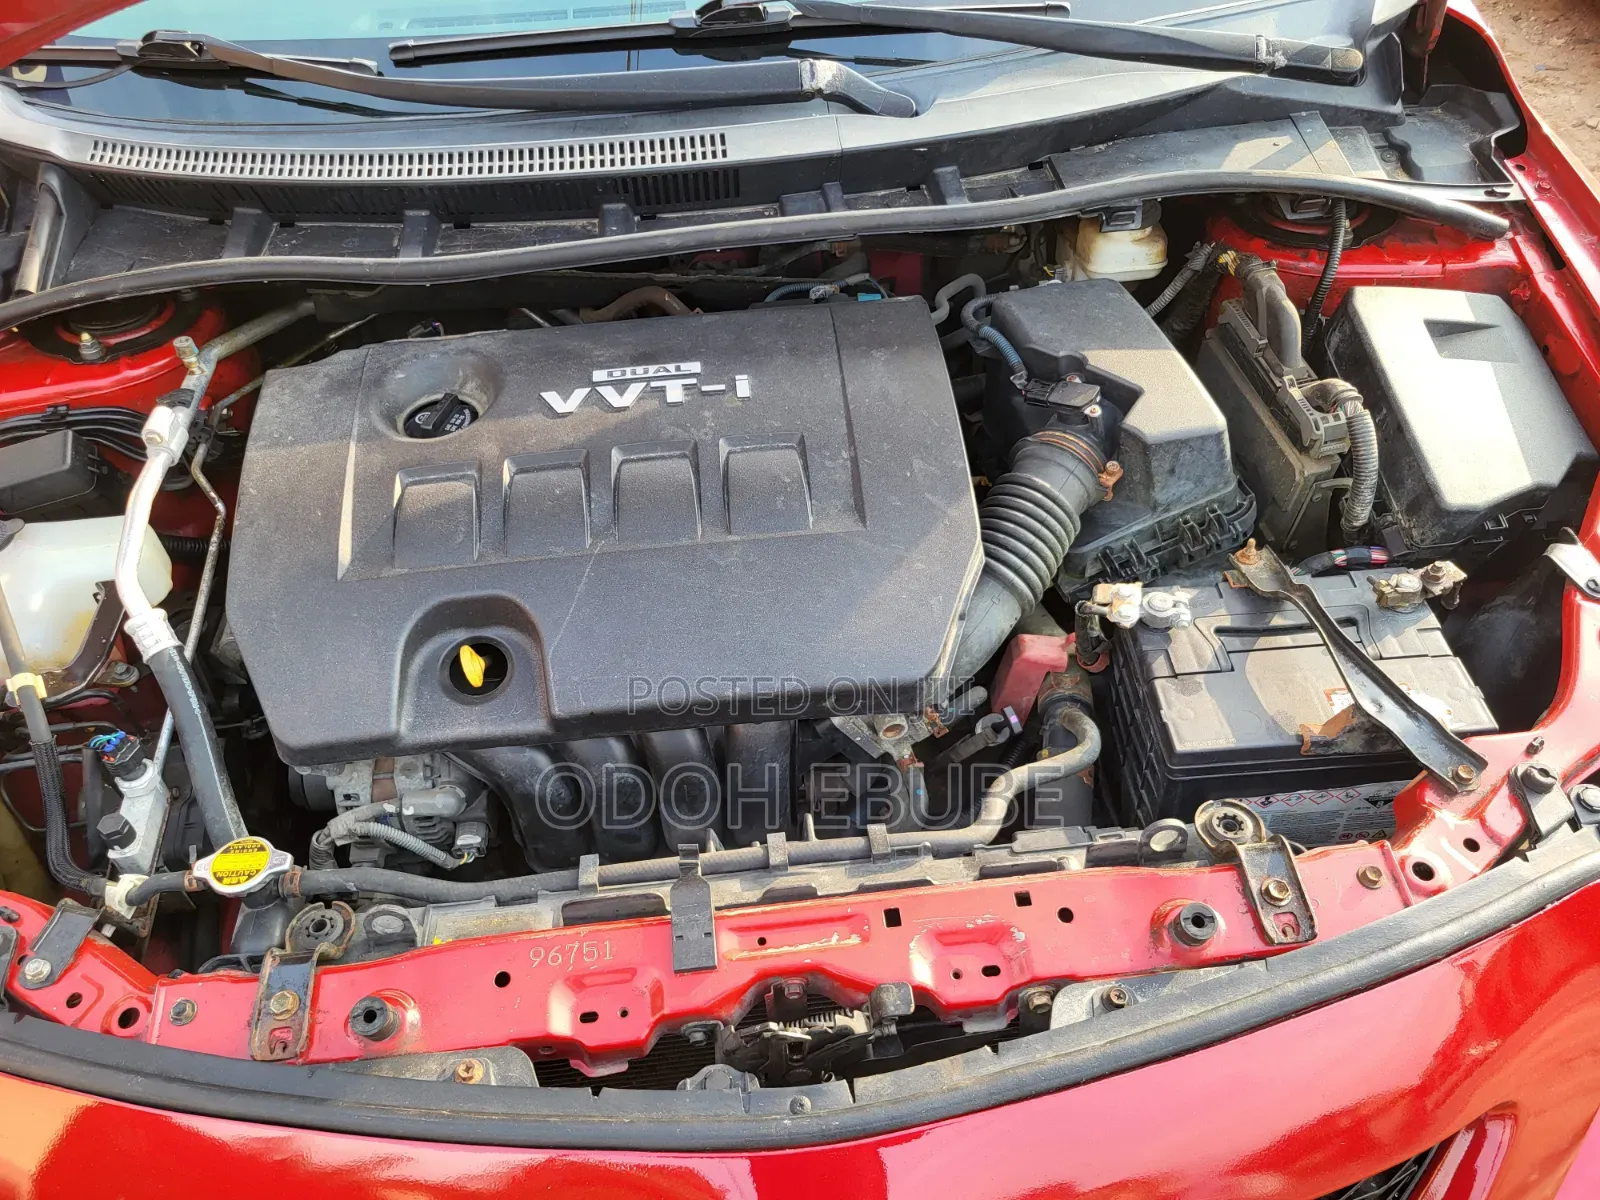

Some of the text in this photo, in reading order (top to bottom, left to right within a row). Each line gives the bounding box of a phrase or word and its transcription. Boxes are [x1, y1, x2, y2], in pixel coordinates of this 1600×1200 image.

[607, 365, 692, 378] DUAL
[539, 374, 751, 415] VVT-i
[216, 869, 257, 877] CAUTION
[529, 940, 614, 968] 96751
